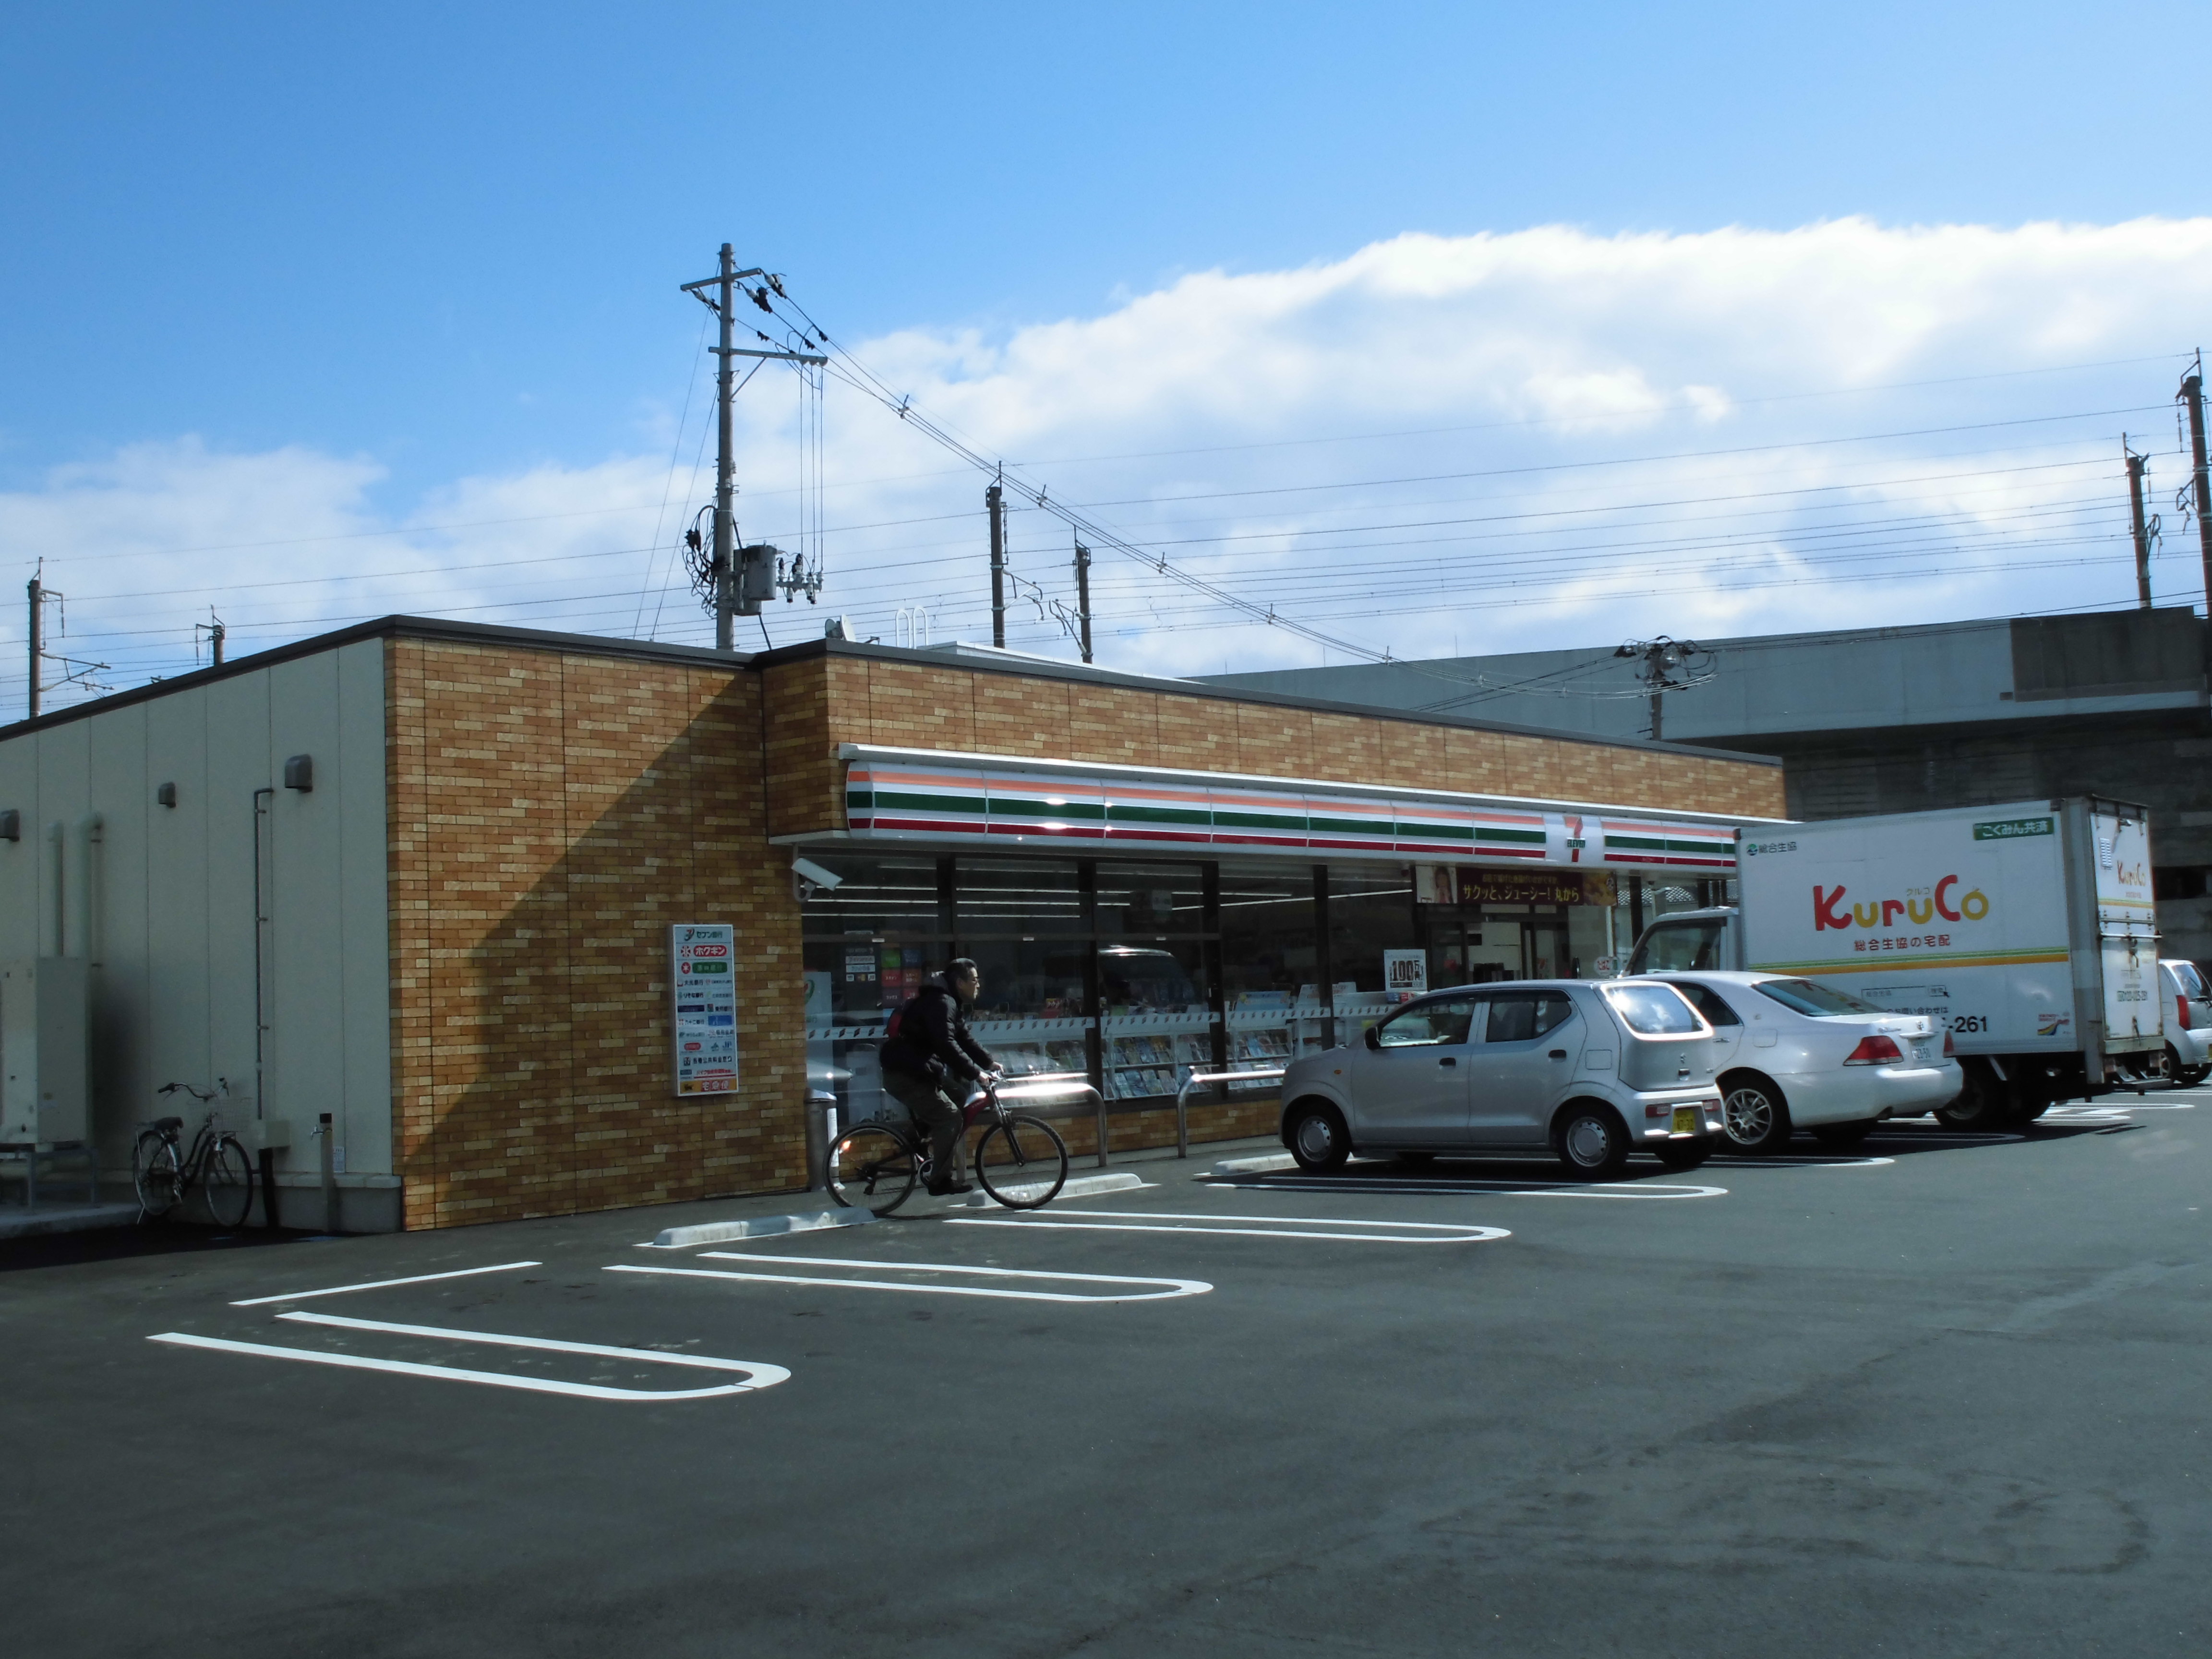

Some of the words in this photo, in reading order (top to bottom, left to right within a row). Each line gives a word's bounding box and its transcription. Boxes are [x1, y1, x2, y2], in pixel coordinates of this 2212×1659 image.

[1758, 842, 1797, 854] 総合生協
[1813, 874, 1989, 931] KuruCo
[1854, 934, 1950, 951] 総合生協の宅配
[1942, 1015, 1987, 1033] -261
